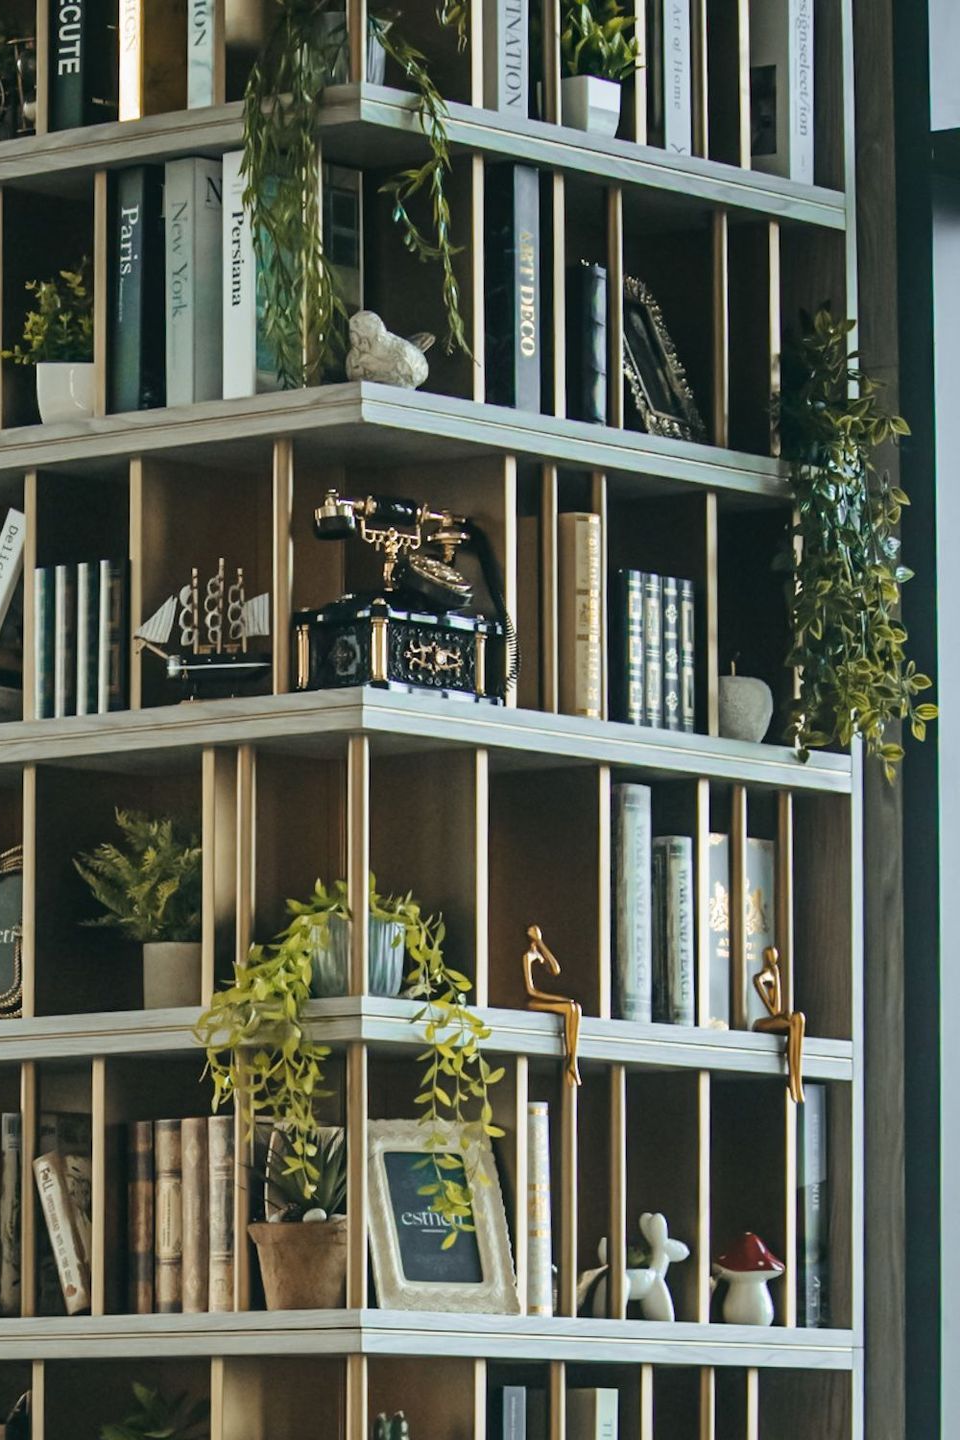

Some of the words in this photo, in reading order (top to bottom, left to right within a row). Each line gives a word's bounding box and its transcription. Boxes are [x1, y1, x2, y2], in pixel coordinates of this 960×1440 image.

[672, 3, 682, 30] Art
[672, 59, 683, 110] Home
[171, 201, 188, 256] New
[231, 211, 245, 307] Persiana
[519, 231, 535, 282] ART
[171, 261, 188, 318] York
[520, 285, 536, 357] DECO
[635, 825, 645, 868] WAR
[635, 875, 645, 915] AND
[678, 869, 688, 904] WAR
[678, 909, 688, 942] AND
[635, 924, 645, 988] PEACE
[680, 948, 689, 1001] PEACE
